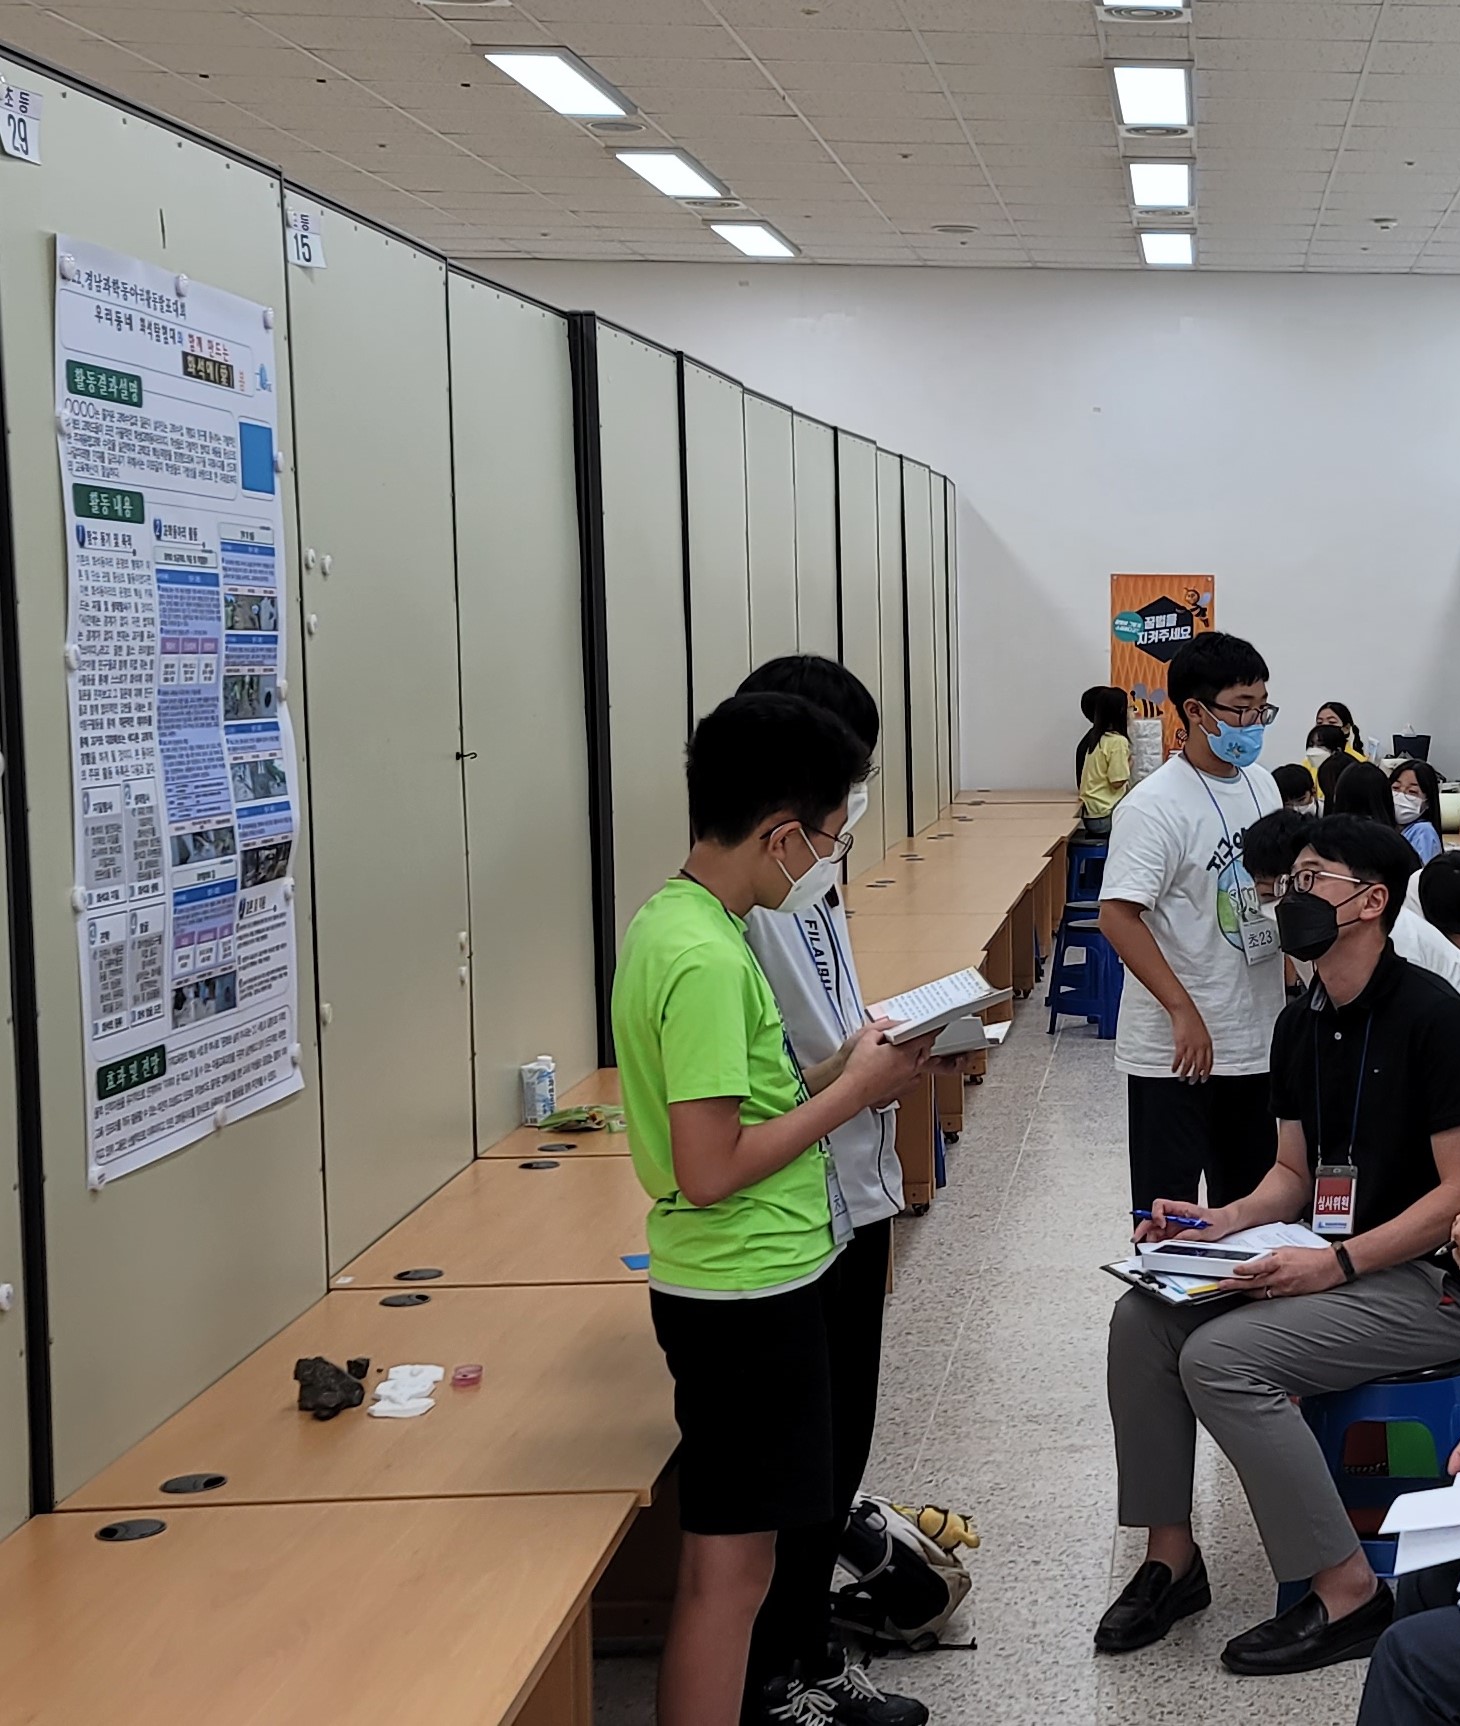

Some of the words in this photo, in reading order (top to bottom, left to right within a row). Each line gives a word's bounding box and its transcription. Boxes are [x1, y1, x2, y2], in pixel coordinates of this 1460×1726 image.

[7, 113, 29, 155] 29
[293, 233, 312, 263] 15
[74, 367, 140, 403] 활동결과설명
[89, 491, 111, 515] 활동
[113, 494, 134, 518] 내용
[1136, 626, 1192, 646] 지켜주세요
[1248, 929, 1273, 948] 초23
[105, 1065, 126, 1091] 효과
[1317, 1195, 1350, 1211] 심사위원
